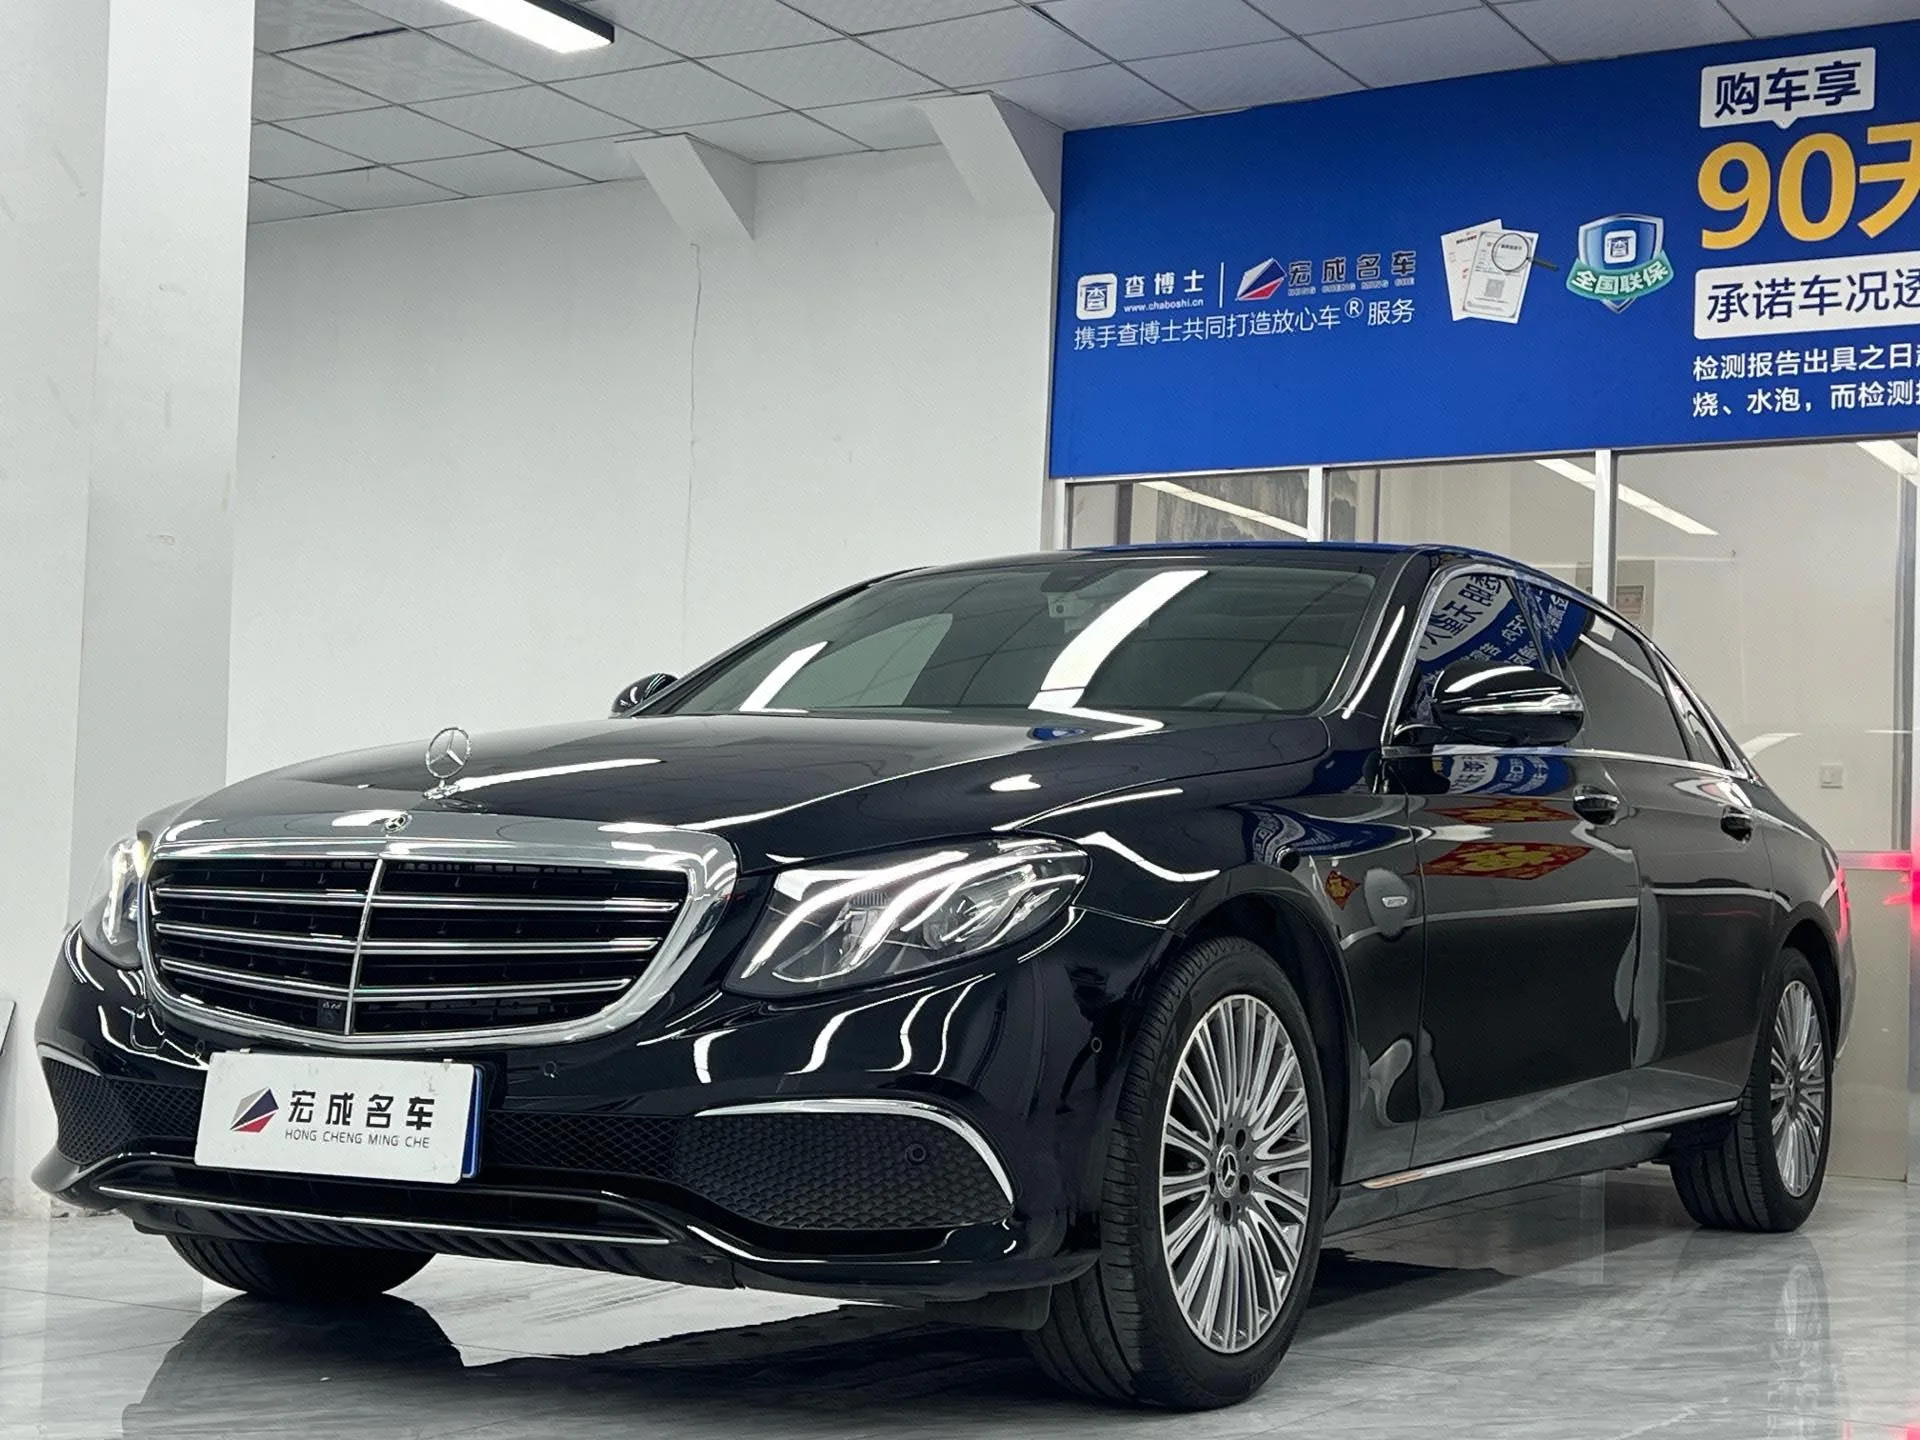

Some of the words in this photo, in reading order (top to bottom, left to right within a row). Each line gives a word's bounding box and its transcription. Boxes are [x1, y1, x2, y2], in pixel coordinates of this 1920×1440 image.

[1714, 60, 1861, 118] 购车享
[1124, 269, 1205, 299] 查博士
[1287, 250, 1417, 287] 宏成名车
[1571, 263, 1668, 296] 全国联保
[1123, 299, 1205, 313] www.chaboshi.cn
[1693, 343, 1920, 382] 检测报告出具之日
[1692, 379, 1920, 418] 烧、水泡，而检测
[288, 1090, 435, 1131] 宏成名车
[284, 1128, 317, 1142] HONG
[322, 1130, 362, 1145] CHENG
[367, 1133, 399, 1147] MING
[405, 1136, 430, 1149] CHE
